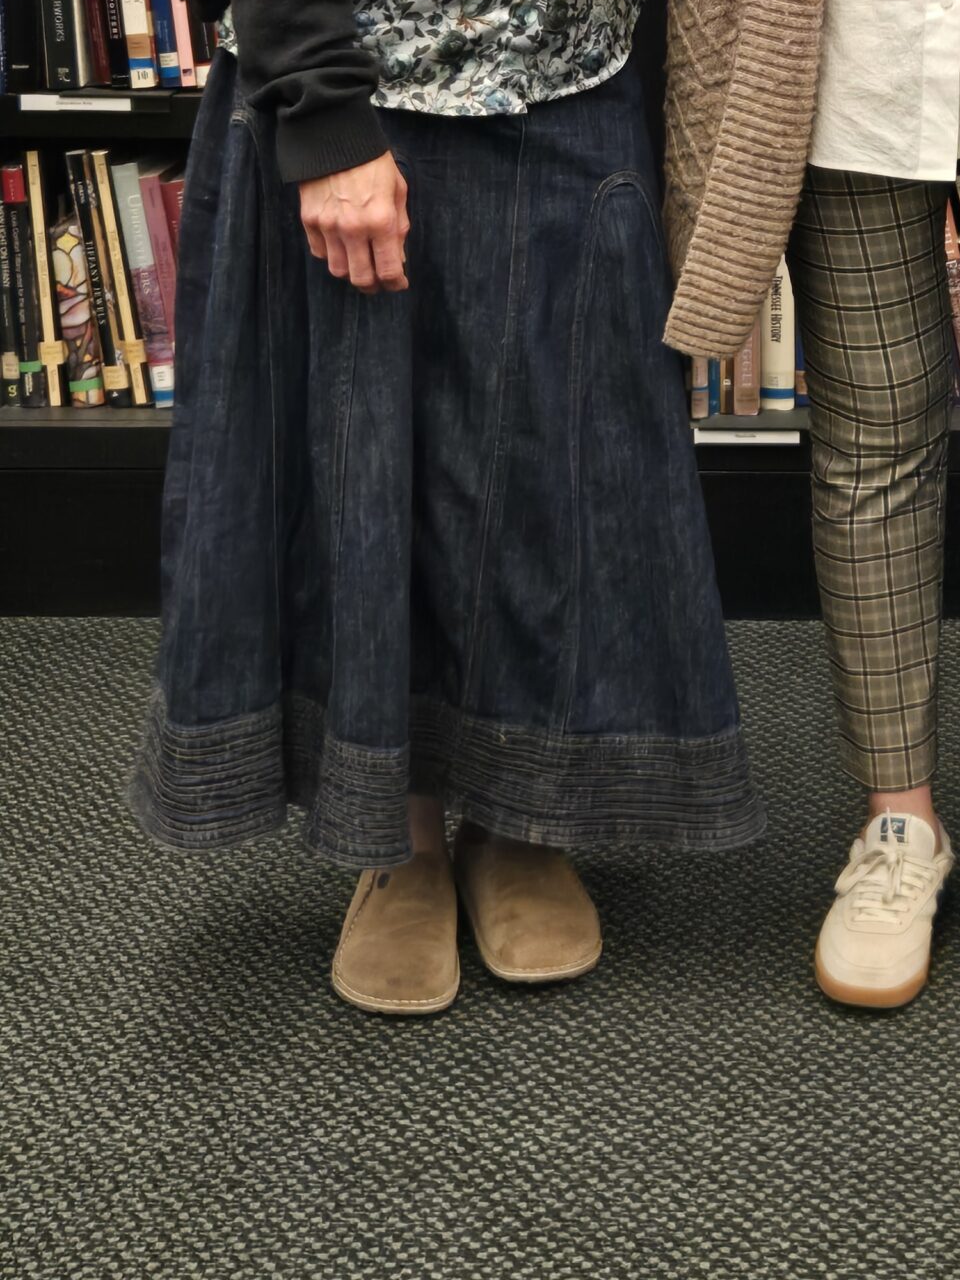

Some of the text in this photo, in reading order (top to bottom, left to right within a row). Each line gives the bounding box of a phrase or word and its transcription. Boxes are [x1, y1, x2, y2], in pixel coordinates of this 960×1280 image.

[85, 241, 107, 325] TIFFANY JEWELS
[771, 274, 784, 343] TENNESSEE HISTORY
